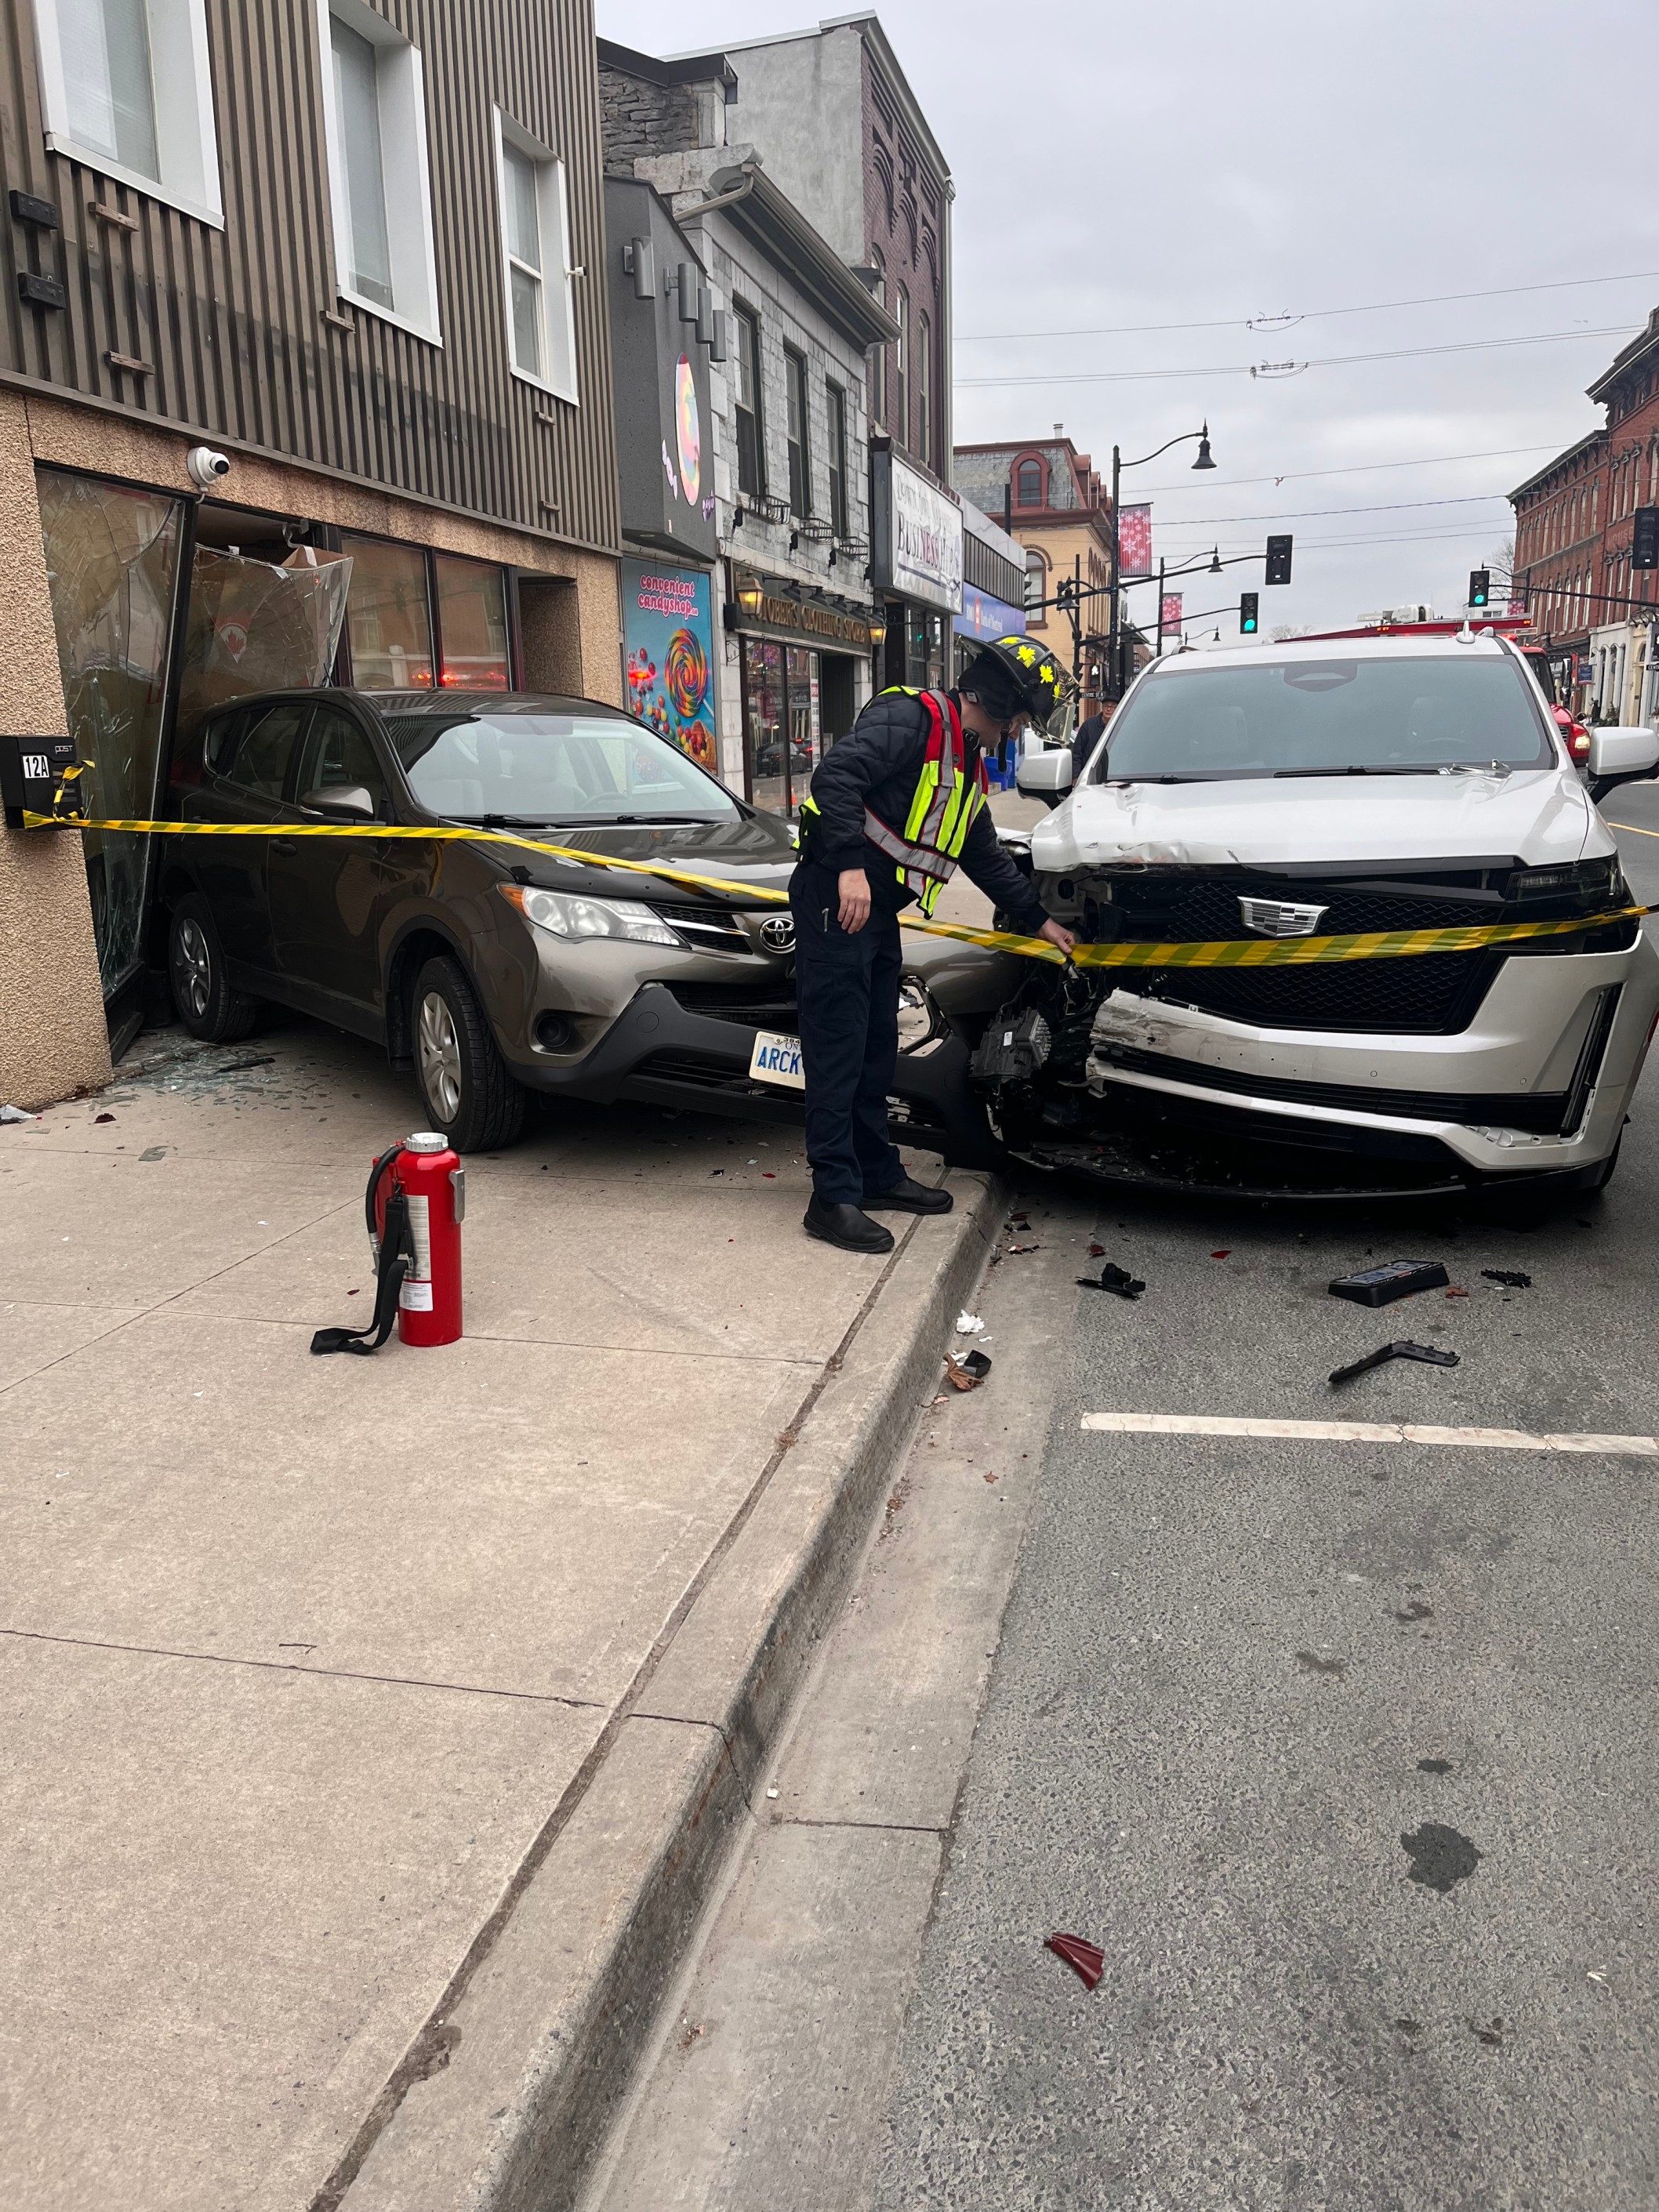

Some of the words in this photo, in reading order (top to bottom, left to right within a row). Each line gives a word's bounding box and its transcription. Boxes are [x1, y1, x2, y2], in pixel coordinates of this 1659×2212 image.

[640, 575, 695, 598] convenient
[801, 604, 841, 638] CLOTHING
[844, 617, 865, 644] STORE
[26, 756, 48, 777] 12A
[757, 1046, 801, 1075] ARCK
